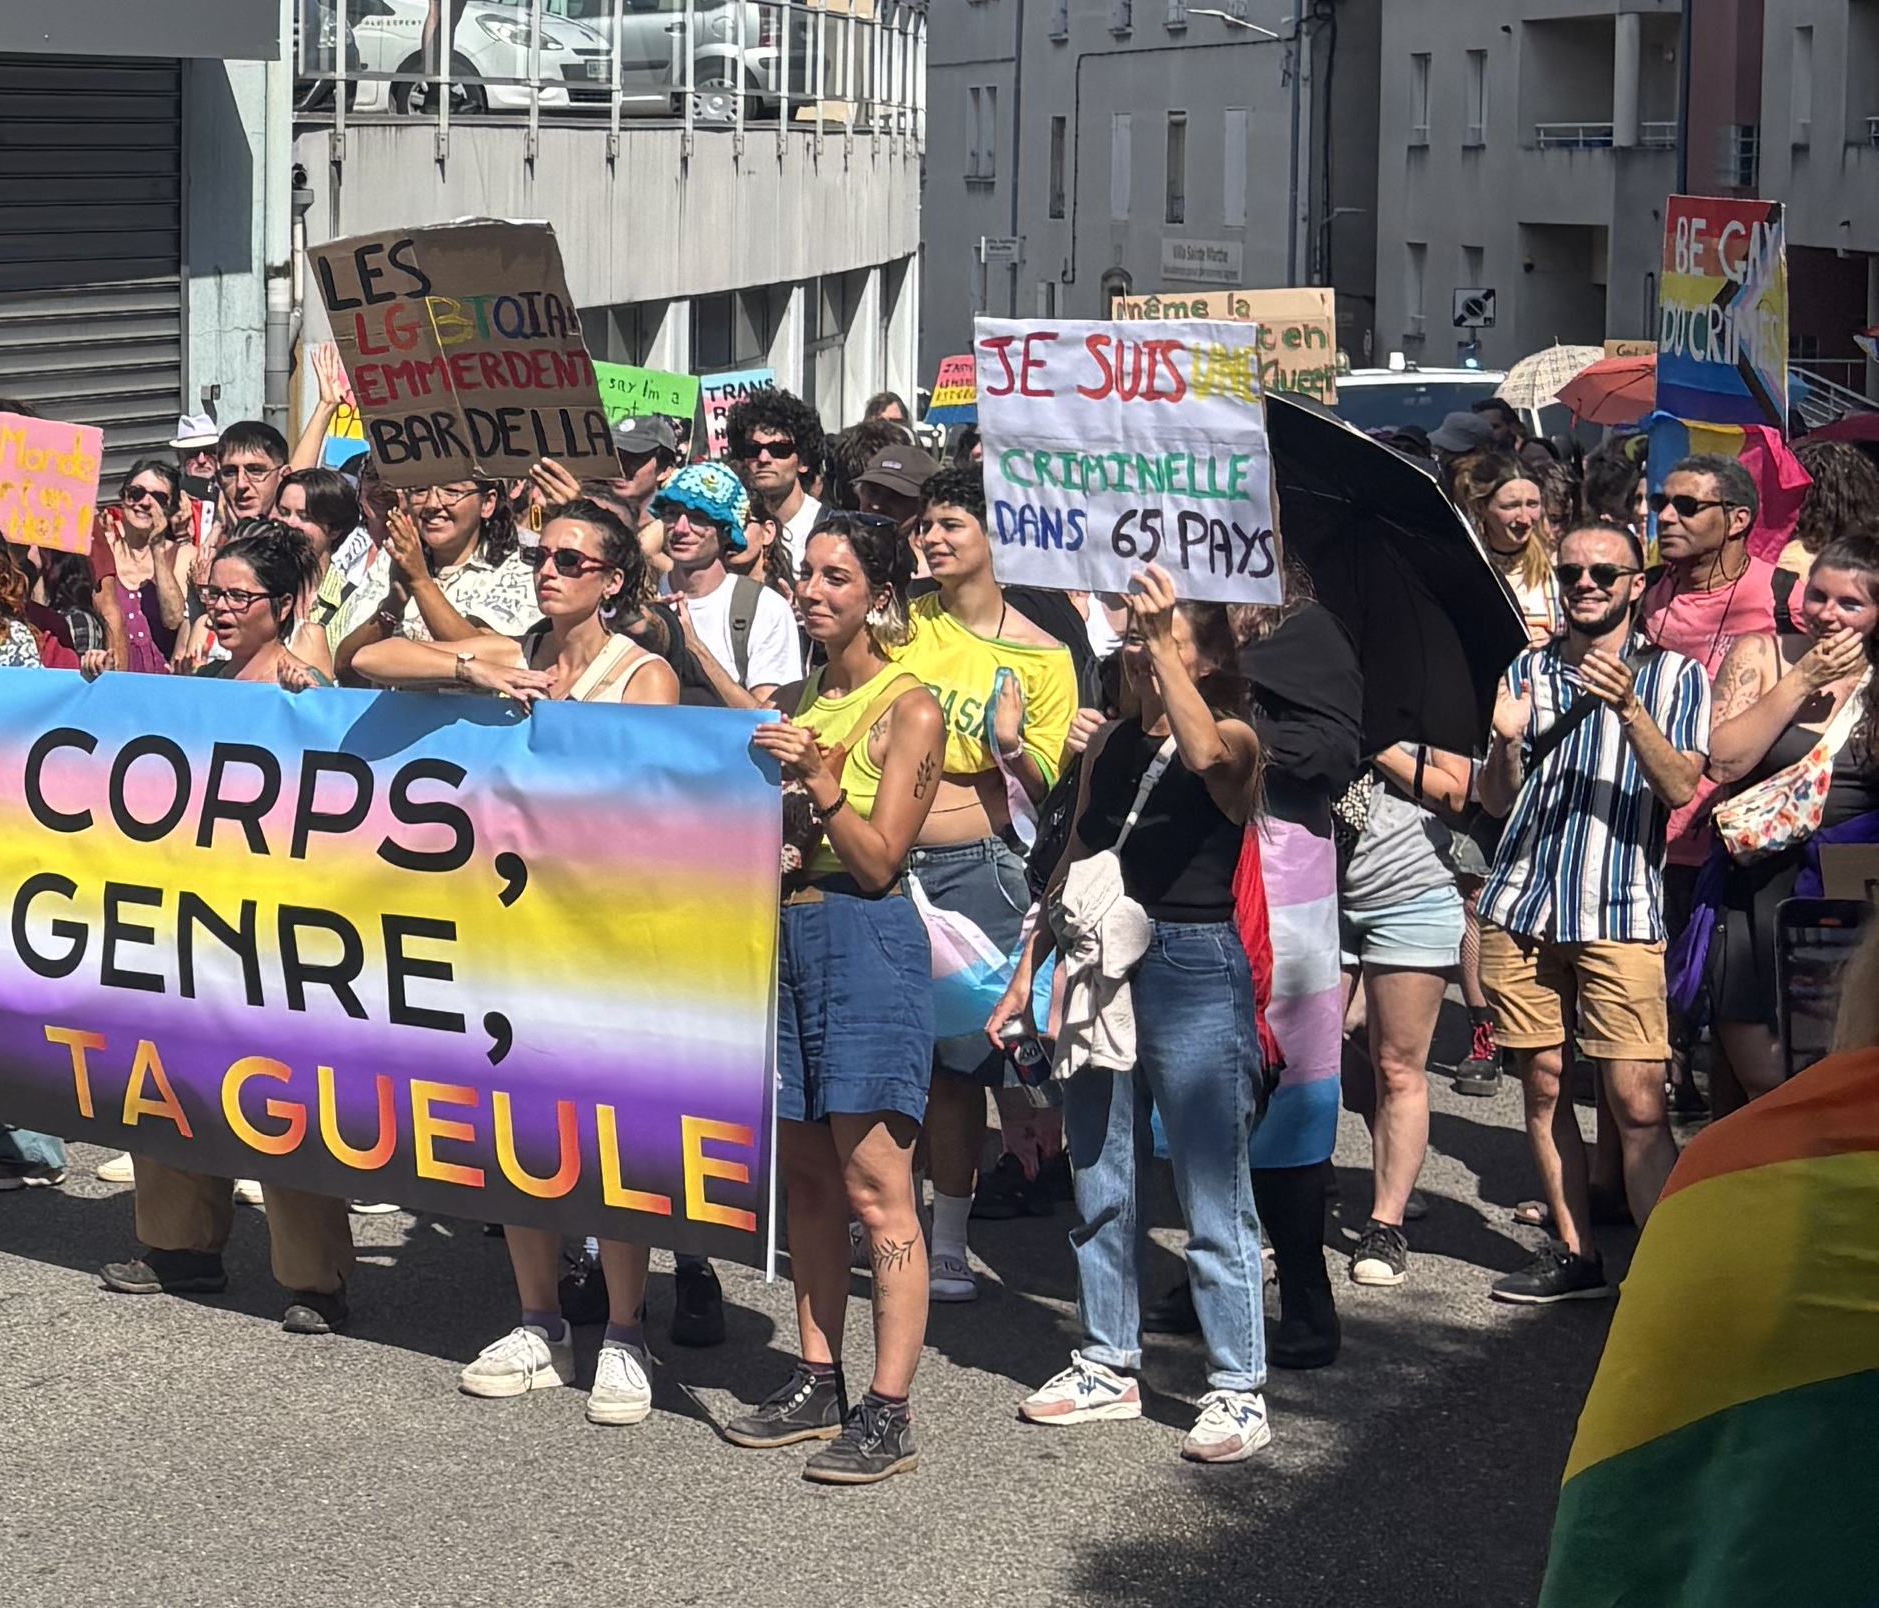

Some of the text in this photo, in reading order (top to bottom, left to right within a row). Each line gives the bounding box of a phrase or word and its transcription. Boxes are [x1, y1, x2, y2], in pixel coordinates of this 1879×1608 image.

[318, 239, 431, 311] LES
[1676, 216, 1781, 285] BE GAY
[1116, 293, 1252, 319] même la
[354, 349, 592, 406] EMMERDENT
[609, 377, 680, 405] say I'm a
[705, 378, 774, 402] TRANS
[980, 331, 1059, 397] JE
[1077, 334, 1186, 403] SUIS
[370, 407, 613, 464] BARDELLA
[1000, 449, 1250, 500] CRIMINELLE
[994, 500, 1274, 578] DANS 65 PAYS
[25, 727, 528, 908] CORPS,
[12, 872, 513, 1066] GENRE,
[44, 1024, 757, 1233] TA GUEULE
